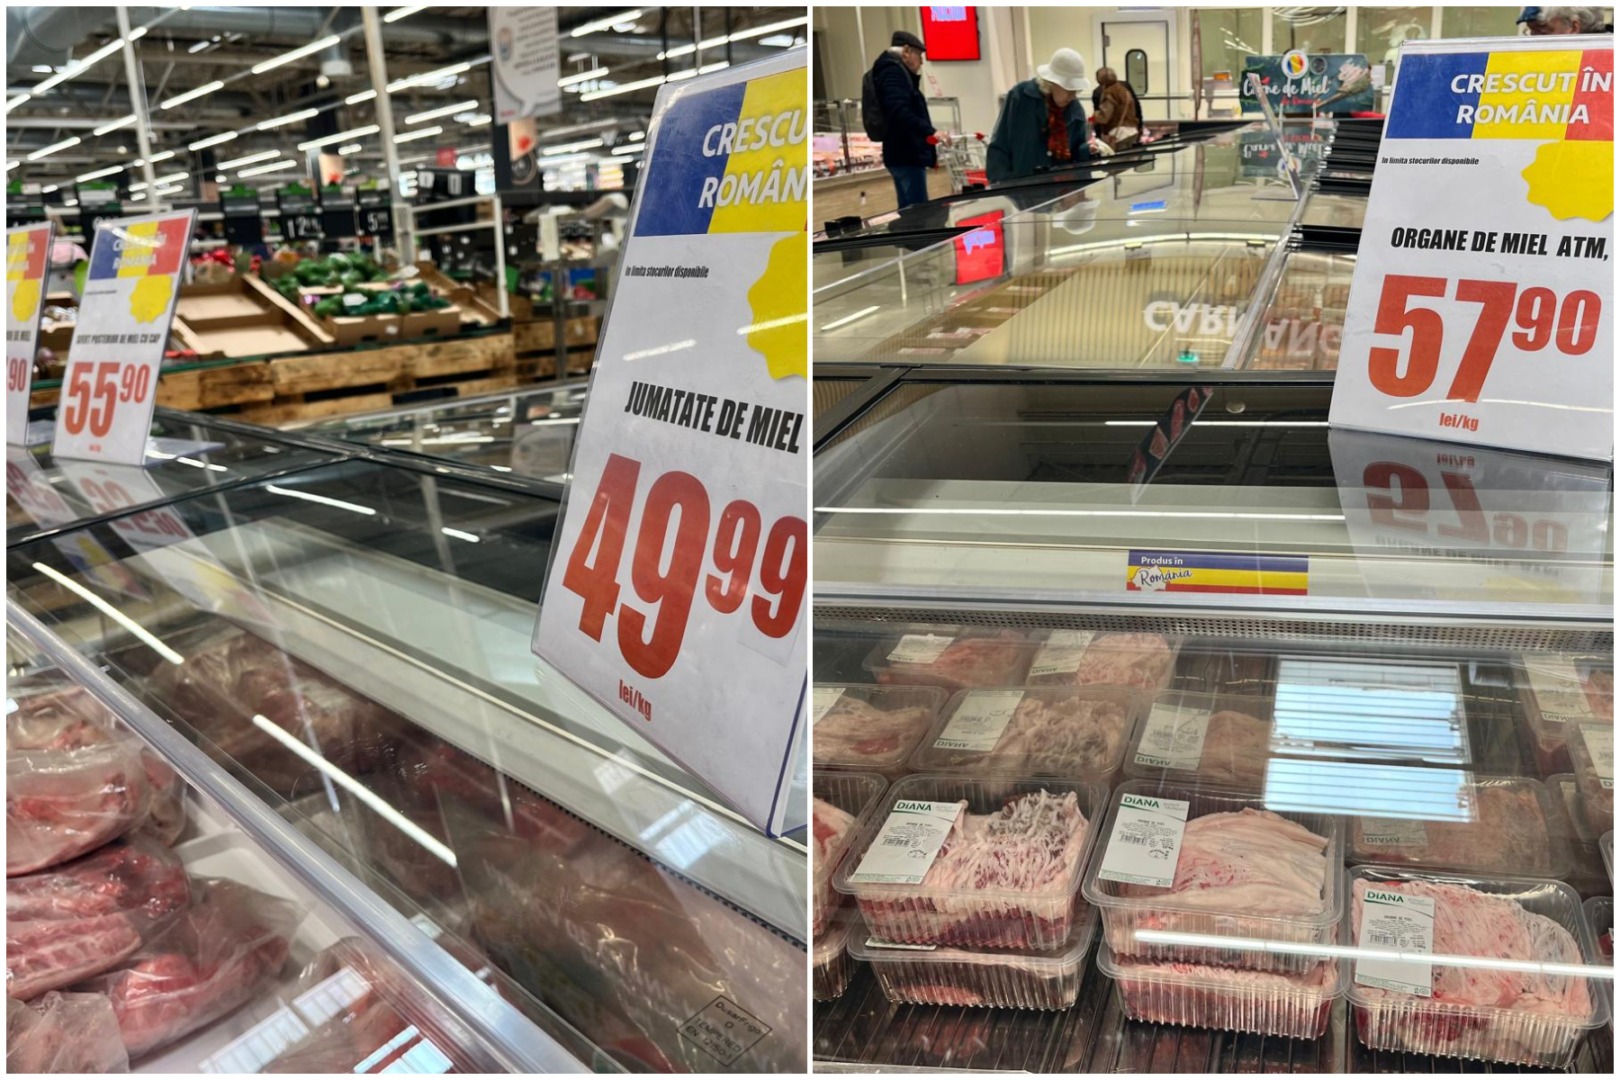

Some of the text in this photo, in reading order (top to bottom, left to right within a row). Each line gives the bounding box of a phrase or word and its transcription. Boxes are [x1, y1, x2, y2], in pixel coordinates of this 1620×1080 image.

[1451, 66, 1612, 94] CRESCUT ÎN
[1456, 98, 1590, 124] ROMÂNIA
[1389, 156, 1408, 164] limita
[1408, 156, 1440, 165] stocurilor
[1441, 156, 1479, 166] disponibile
[698, 160, 807, 208] ROMÂN
[1390, 227, 1608, 261] ORGANE DE MIEL ATM,
[646, 265, 674, 278] stocurilor
[674, 266, 709, 278] disponibile
[625, 381, 804, 454] JUMATATE DE MIEL
[1439, 412, 1479, 432] lei/kg
[1140, 556, 1172, 565] Produs
[619, 679, 652, 722] lei/kg
